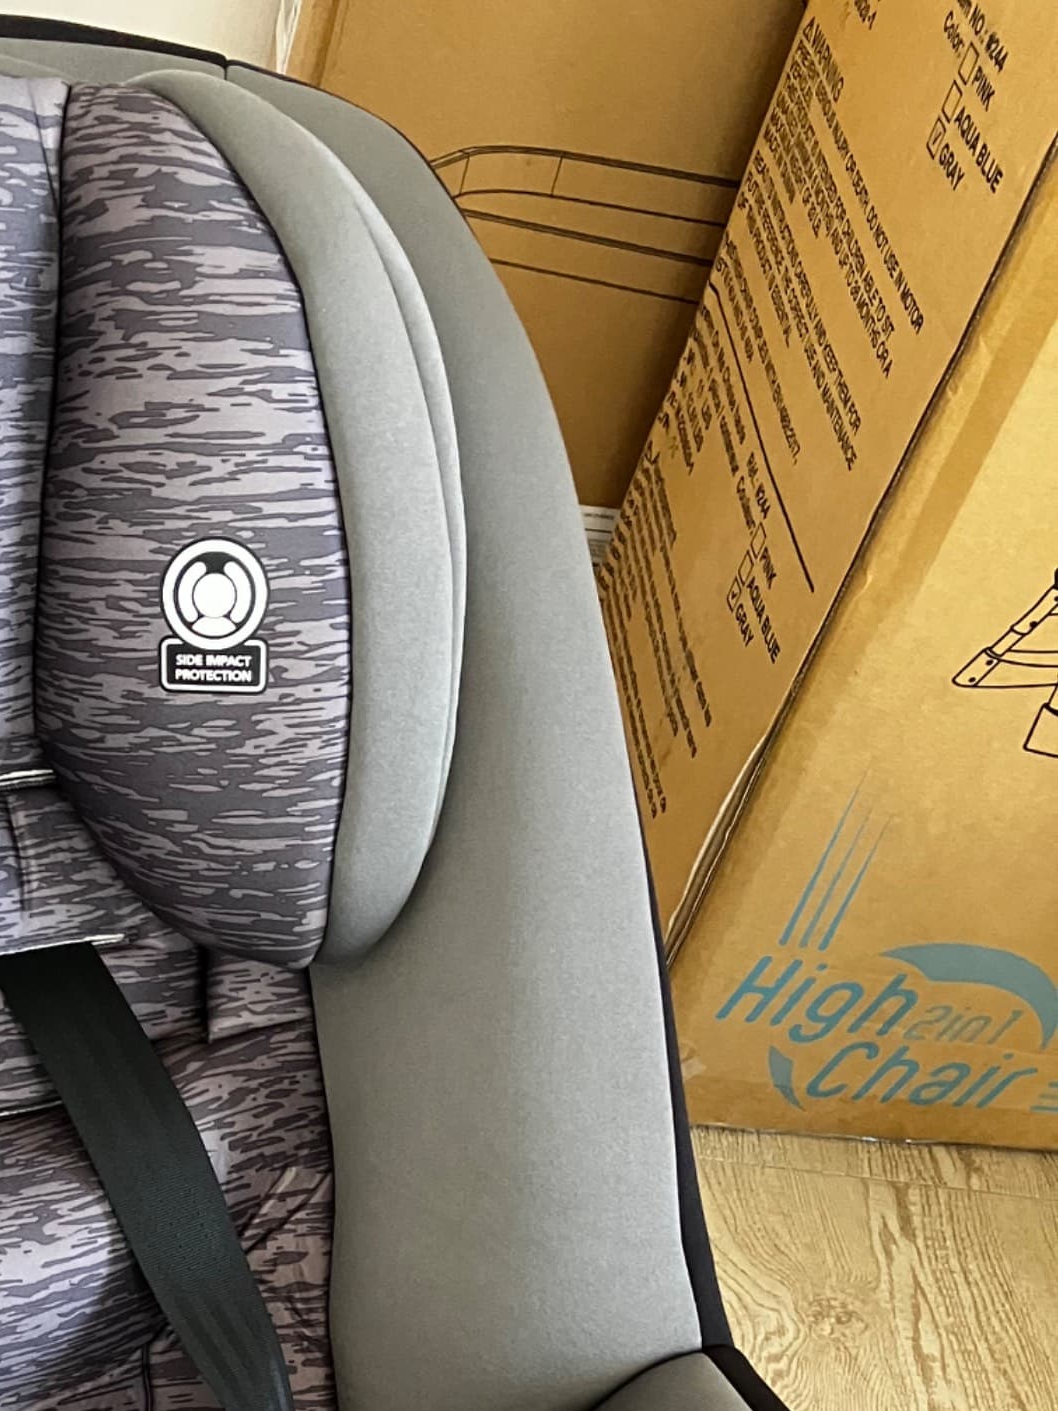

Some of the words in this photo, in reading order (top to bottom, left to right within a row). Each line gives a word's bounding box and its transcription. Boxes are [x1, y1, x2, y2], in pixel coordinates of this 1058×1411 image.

[943, 10, 965, 58] Color:
[971, 66, 995, 112] PINK
[939, 143, 965, 190] GRAY
[954, 106, 980, 156] AQUA
[976, 143, 1003, 193] BLUE
[862, 270, 879, 307] ABLE
[866, 205, 878, 231] DO
[873, 223, 889, 254] NOT
[883, 247, 899, 279] USE
[900, 282, 924, 334] MOTOR
[856, 293, 881, 349] MONTHS
[822, 341, 839, 373] KEEP
[834, 368, 852, 409] THEM
[846, 402, 861, 436] FOR
[821, 383, 857, 470] MAINTENANCE
[759, 547, 777, 589] PINK
[735, 603, 754, 647] GRAY
[747, 576, 765, 624] AQUA
[761, 615, 781, 664] BLUE
[175, 668, 252, 682] PROTECTION
[176, 654, 202, 666] SIDE
[205, 655, 252, 667] IMPACT
[715, 955, 919, 1044] High
[903, 1005, 1023, 1045] 2in1
[806, 1041, 1038, 1109] Chair
